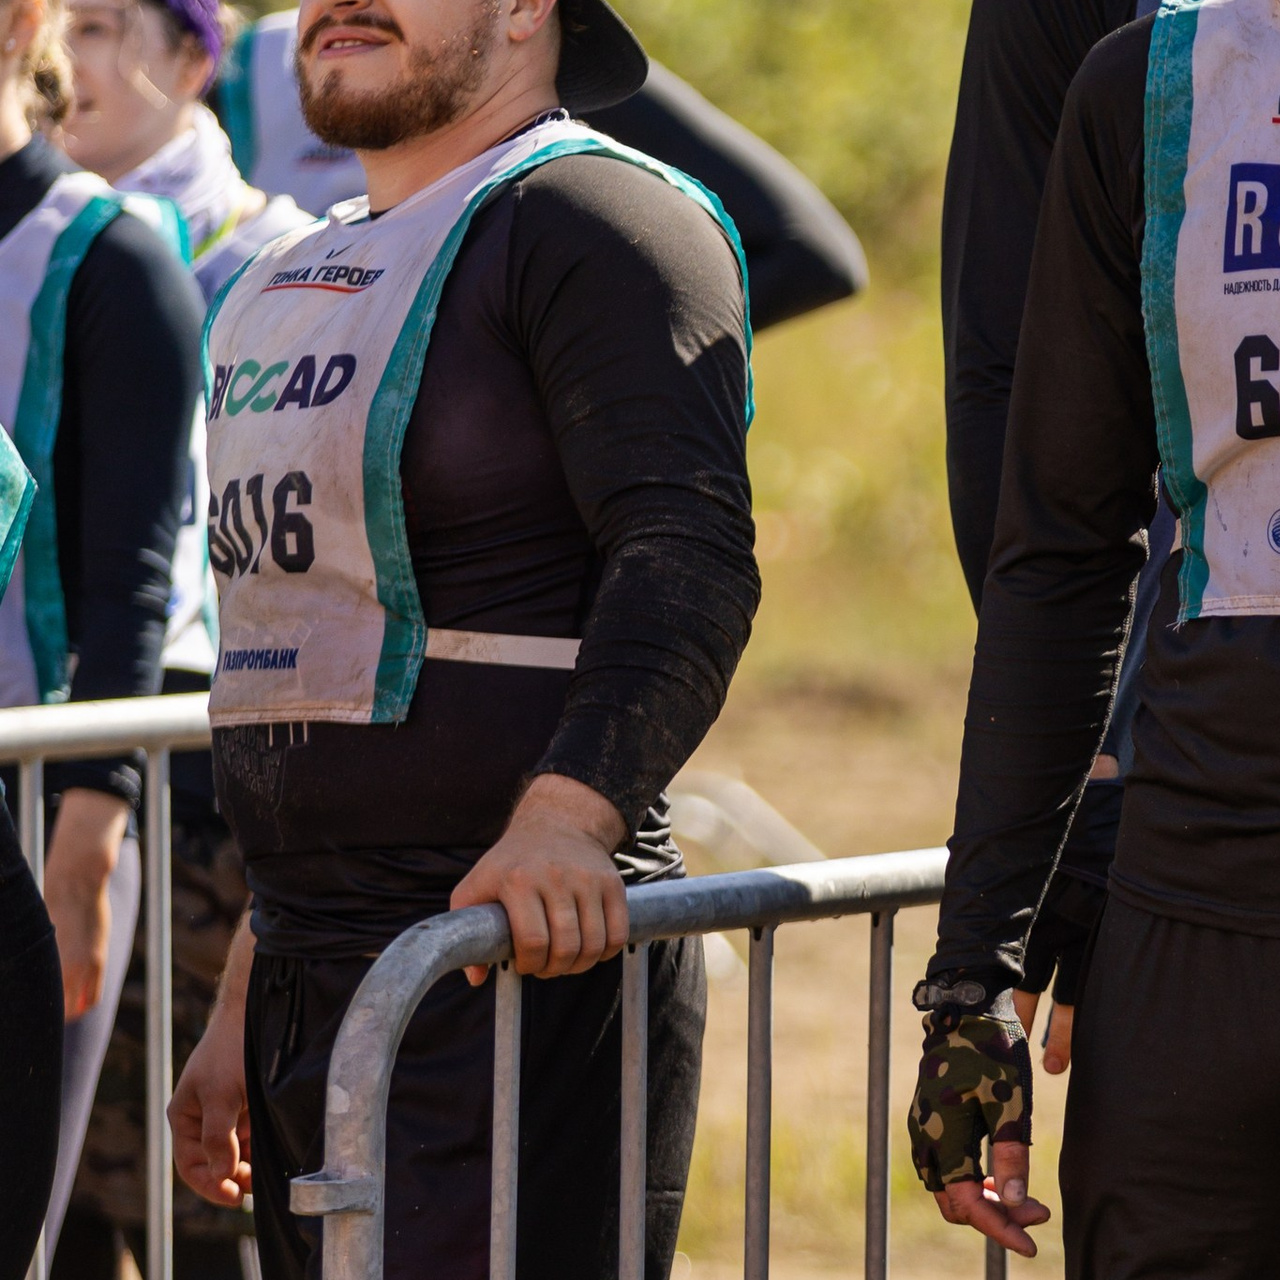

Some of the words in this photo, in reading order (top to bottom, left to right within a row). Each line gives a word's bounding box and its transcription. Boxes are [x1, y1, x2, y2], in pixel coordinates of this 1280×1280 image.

[1223, 278, 1272, 296] НАДЕЖНОСТЬ
[207, 470, 316, 579] 6016
[222, 647, 300, 672] ГАЗПРОМБАНК
